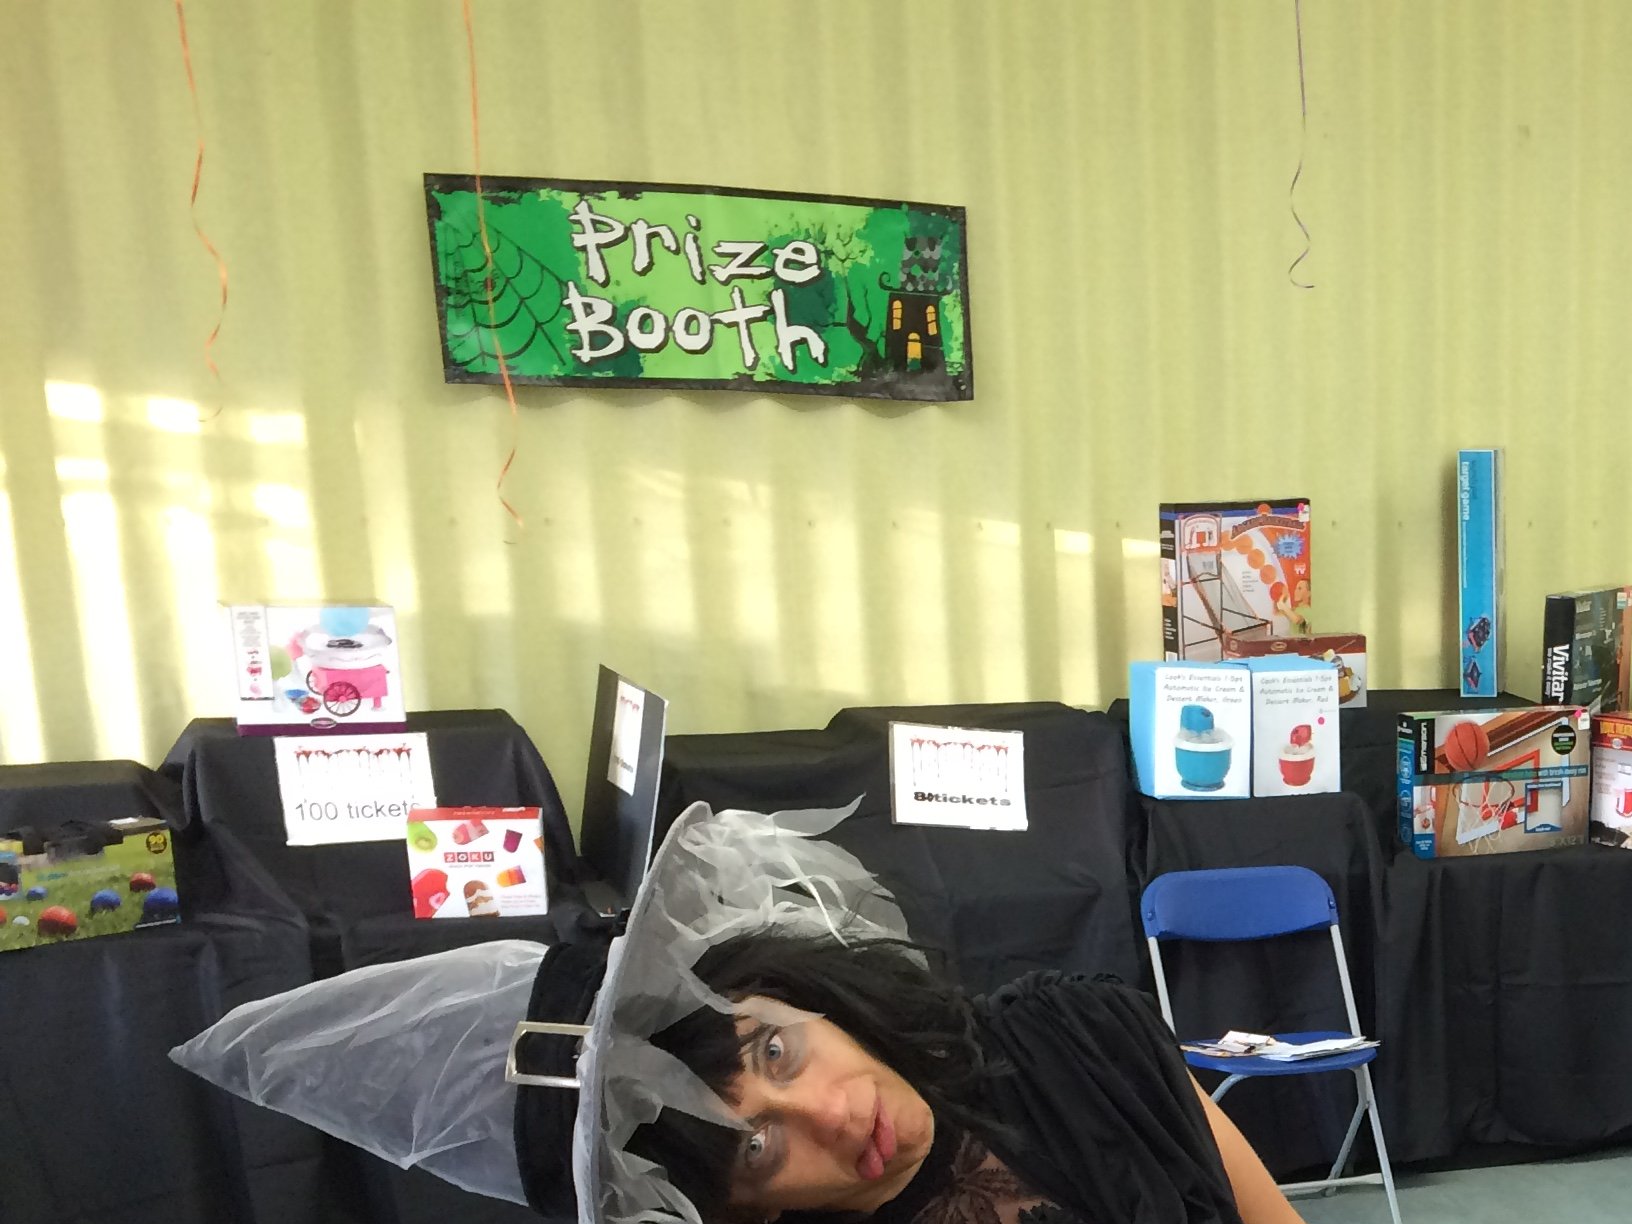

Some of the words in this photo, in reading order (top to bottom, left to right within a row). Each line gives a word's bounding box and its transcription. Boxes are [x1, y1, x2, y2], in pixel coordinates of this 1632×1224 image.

[567, 199, 821, 285] Prize
[563, 281, 827, 370] Booth
[1460, 491, 1470, 520] game
[1551, 643, 1570, 704] Vivitar
[295, 801, 340, 821] 100
[934, 792, 1011, 806] tickets
[444, 851, 494, 863] ZOKU
